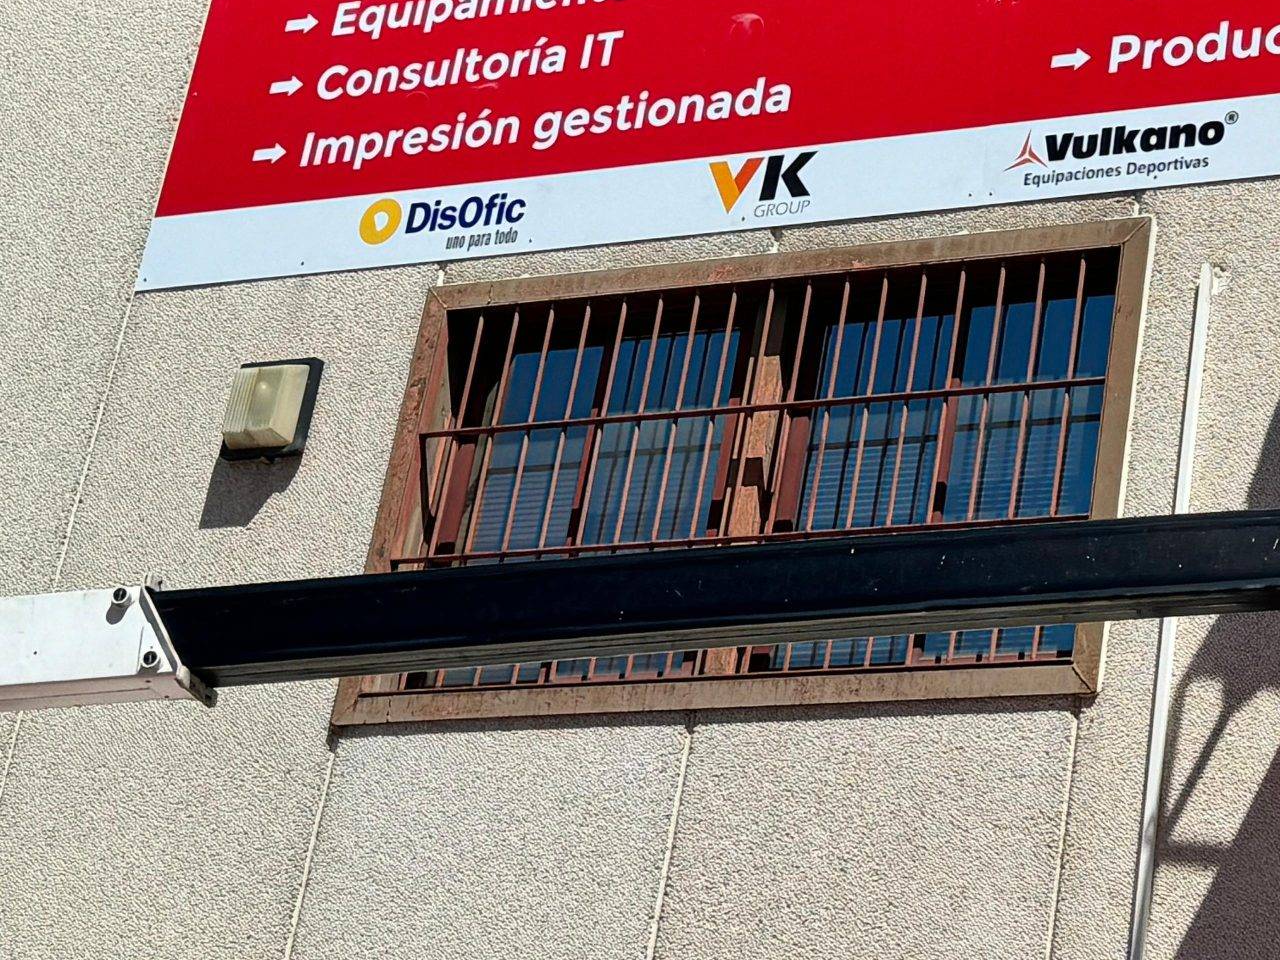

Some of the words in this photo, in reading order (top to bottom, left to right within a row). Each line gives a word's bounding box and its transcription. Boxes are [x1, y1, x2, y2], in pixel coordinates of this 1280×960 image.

[317, 37, 566, 100] Consultoría
[580, 30, 624, 69] IT
[300, 109, 519, 169] Impresión
[532, 77, 792, 150] gestionada
[709, 151, 819, 214] VK
[1022, 163, 1122, 188] Equipaciones
[1126, 152, 1210, 178] Deportivas
[404, 192, 527, 234] DisOfic
[754, 198, 811, 218] GROUP
[445, 235, 466, 250] uno
[467, 231, 492, 252] para
[494, 226, 519, 245] todo
